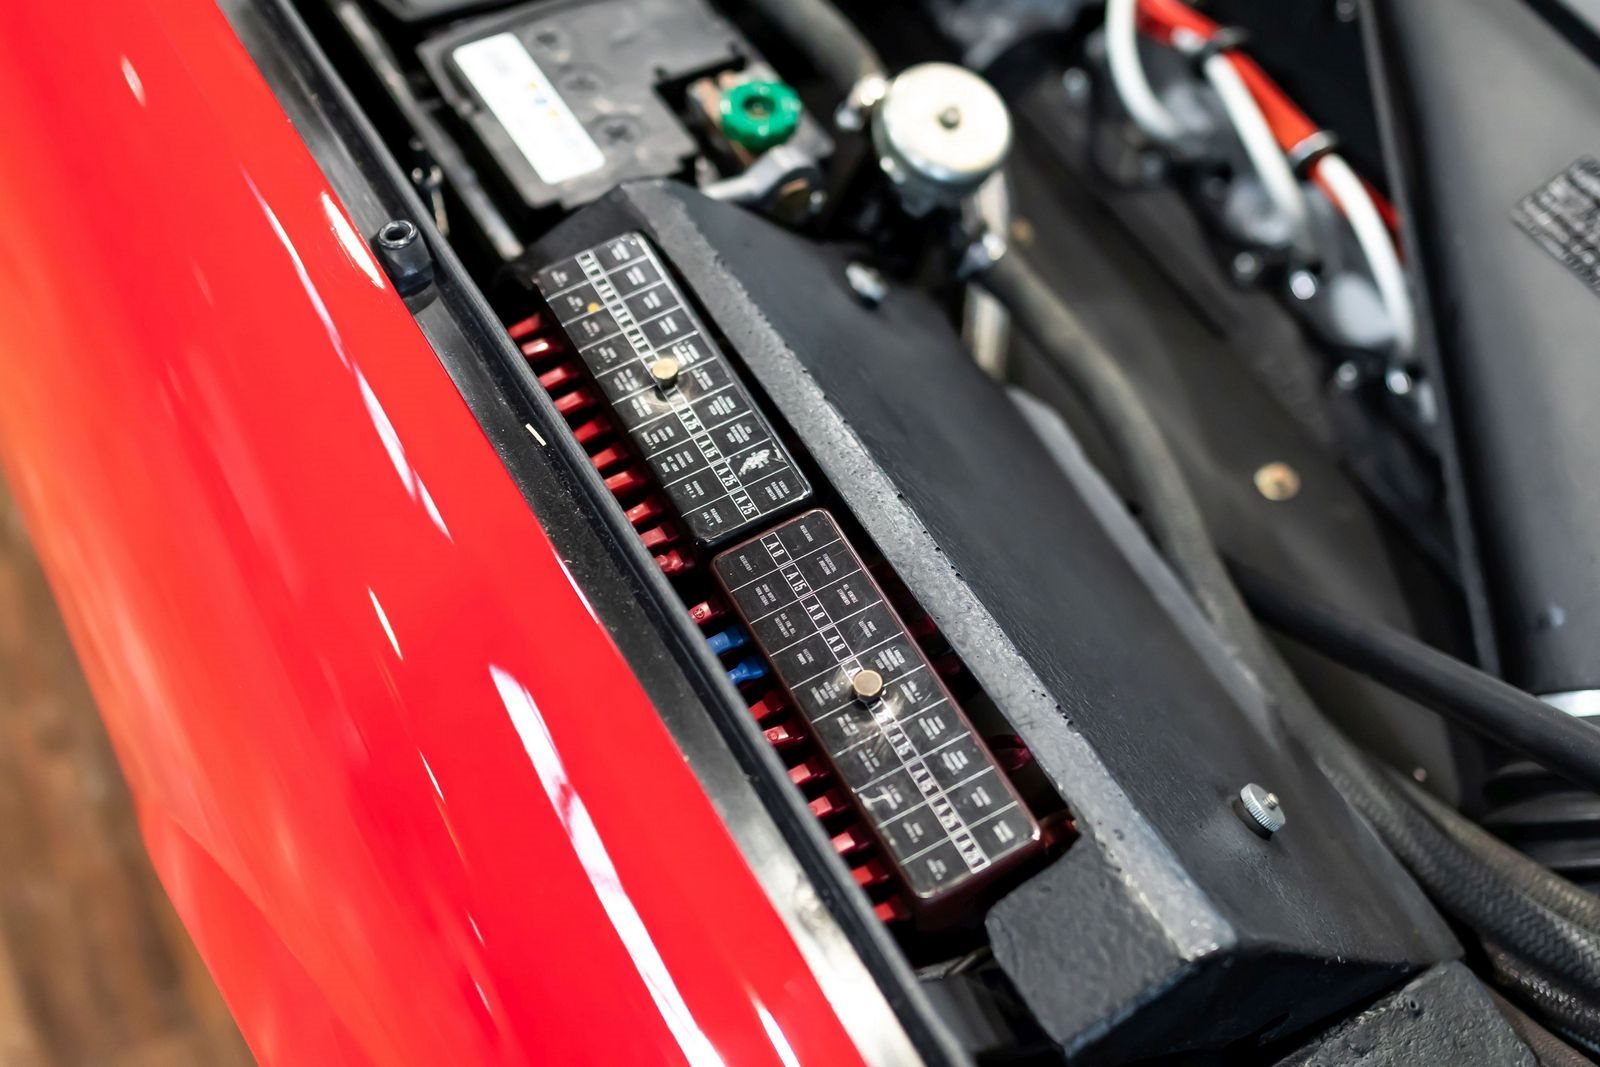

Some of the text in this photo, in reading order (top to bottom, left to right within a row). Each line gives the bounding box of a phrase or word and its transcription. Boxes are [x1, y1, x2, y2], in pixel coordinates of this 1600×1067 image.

[680, 409, 701, 430] A 25
[699, 438, 720, 458] A 15
[717, 467, 737, 487] A 25
[735, 496, 756, 515] A 25
[767, 542, 785, 558] A 8
[786, 572, 807, 592] A 15
[807, 604, 825, 621] A 8
[827, 635, 846, 652] A 8
[888, 733, 914, 758] A 15
[911, 768, 928, 781] A
[933, 800, 951, 816] A
